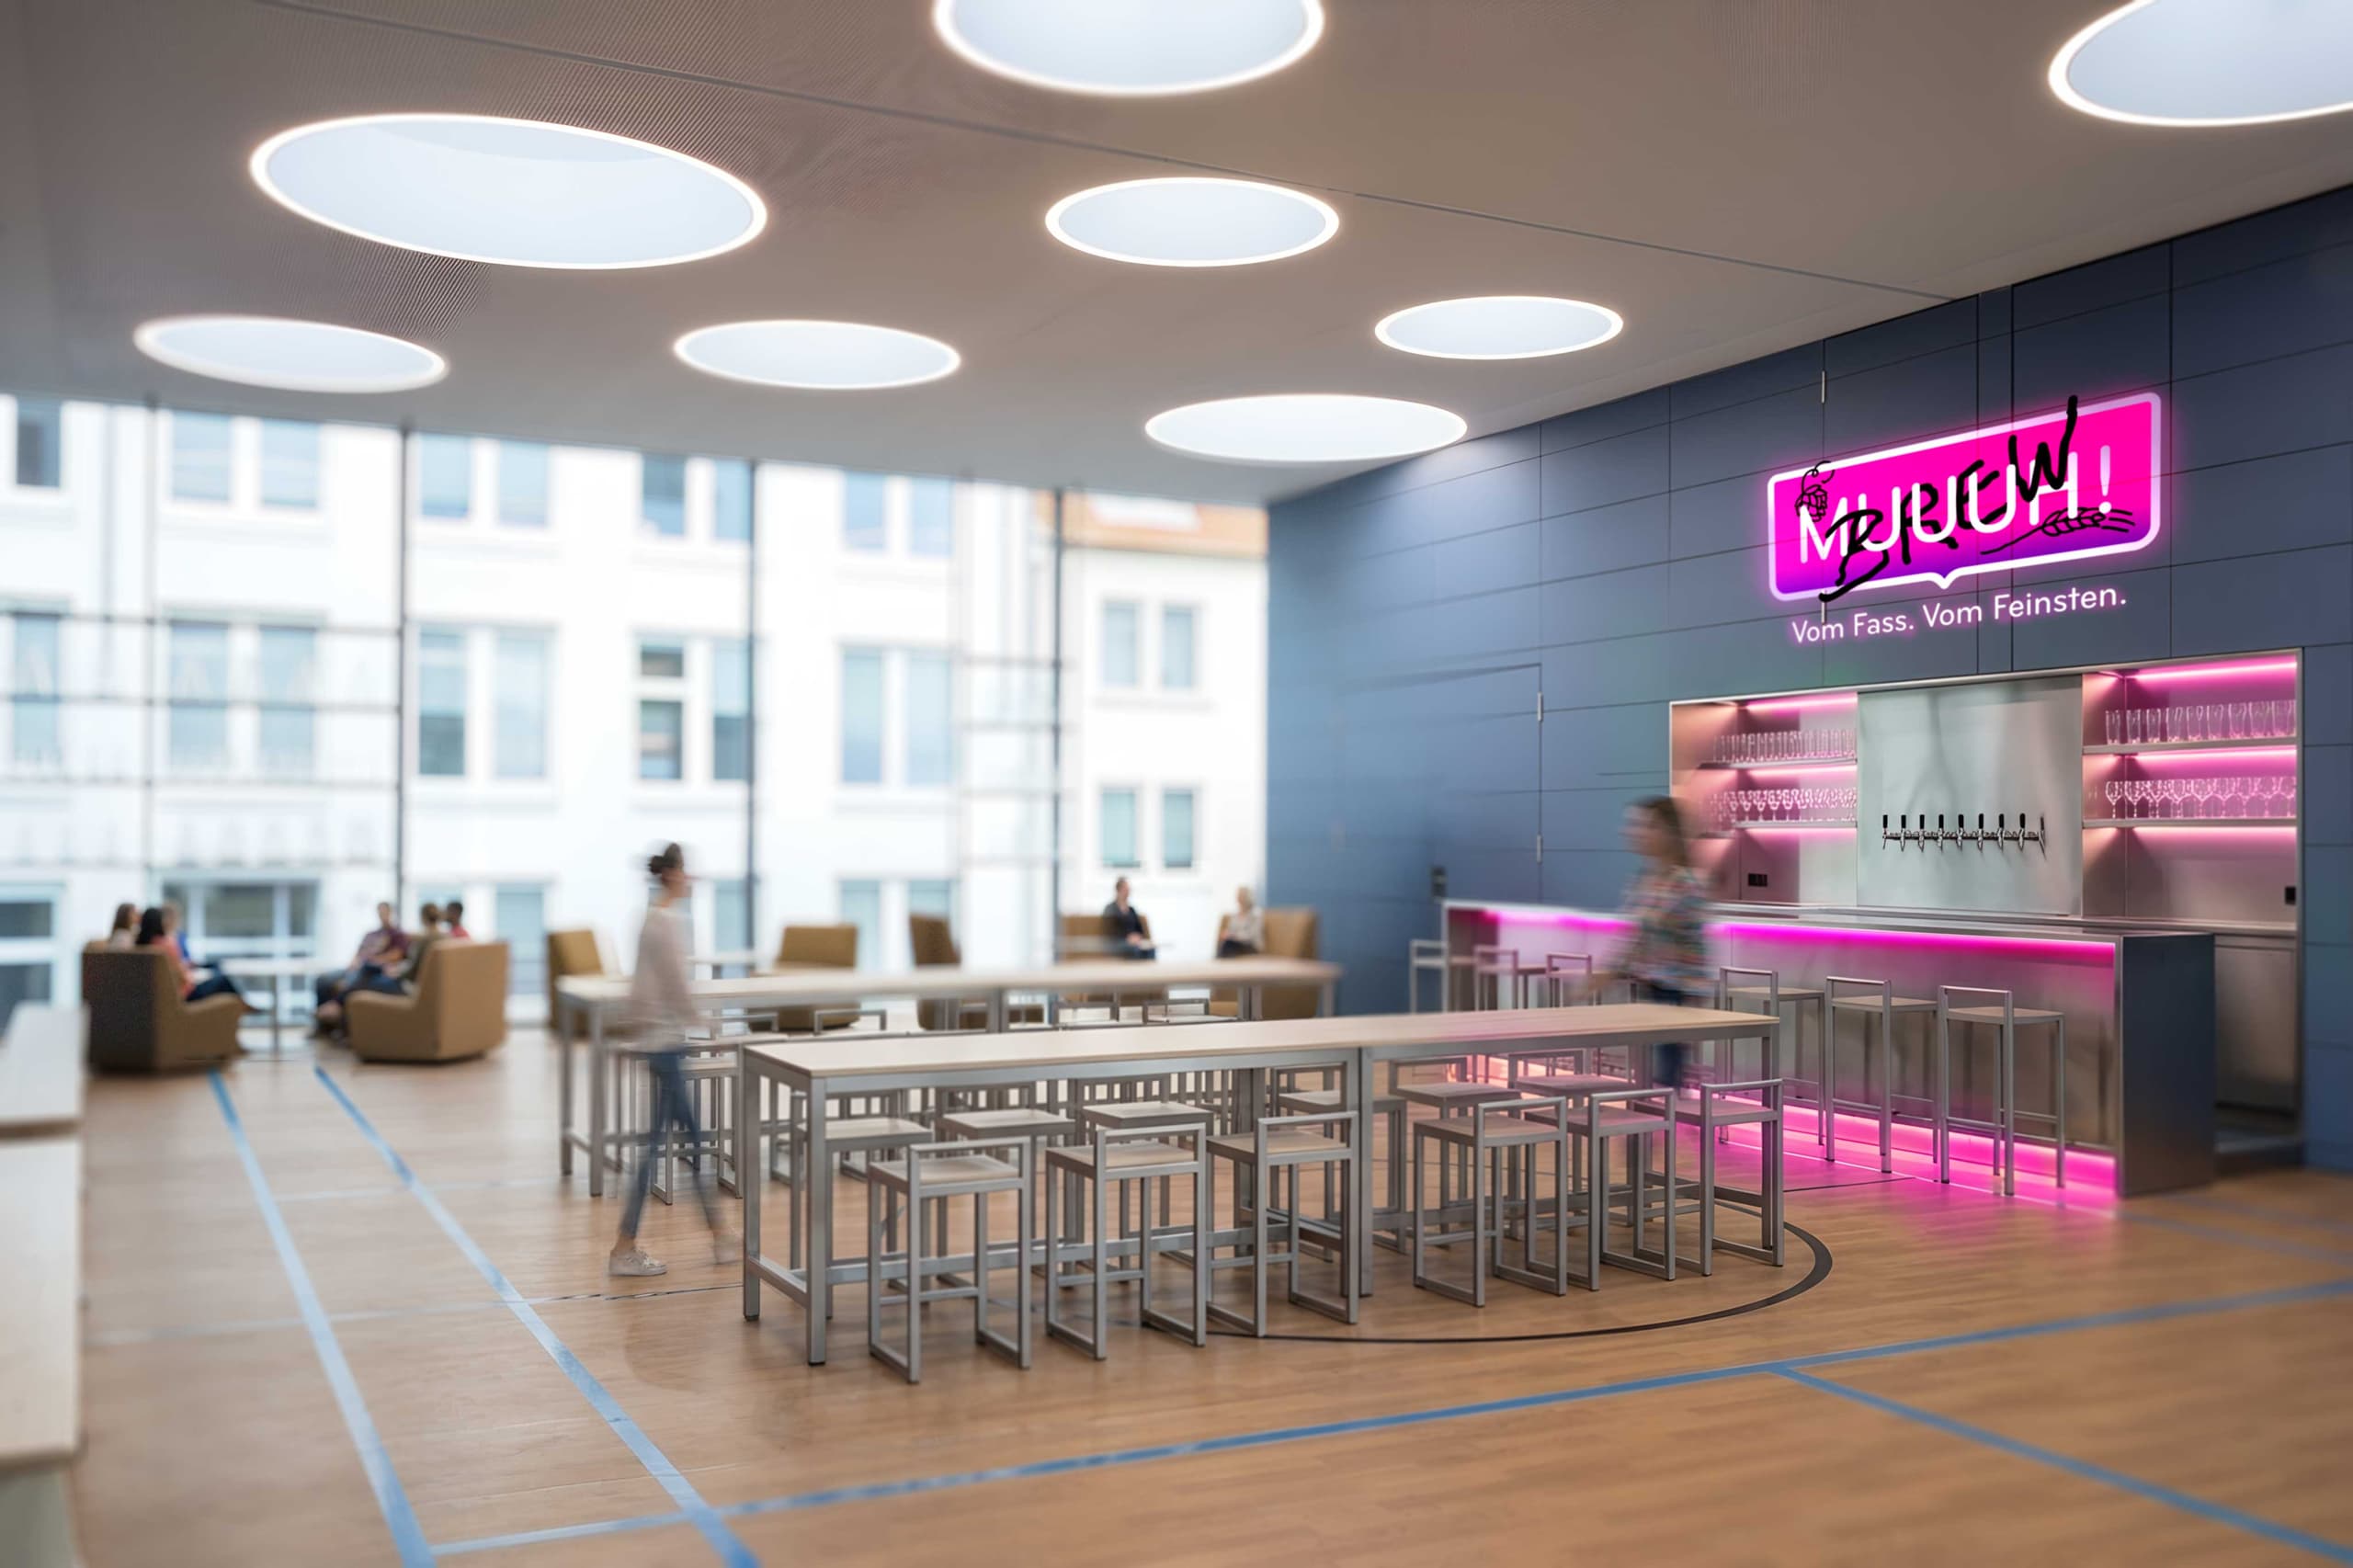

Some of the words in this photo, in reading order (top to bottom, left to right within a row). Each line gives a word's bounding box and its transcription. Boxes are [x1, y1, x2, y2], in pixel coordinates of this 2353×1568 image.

[1799, 445, 2112, 564] MUUUH!
[1819, 395, 2078, 603] BREW
[1791, 620, 1844, 643] Vom
[1854, 612, 1915, 637] Fass.
[1923, 603, 1983, 628] Vom
[1994, 586, 2127, 619] Feinsten.
